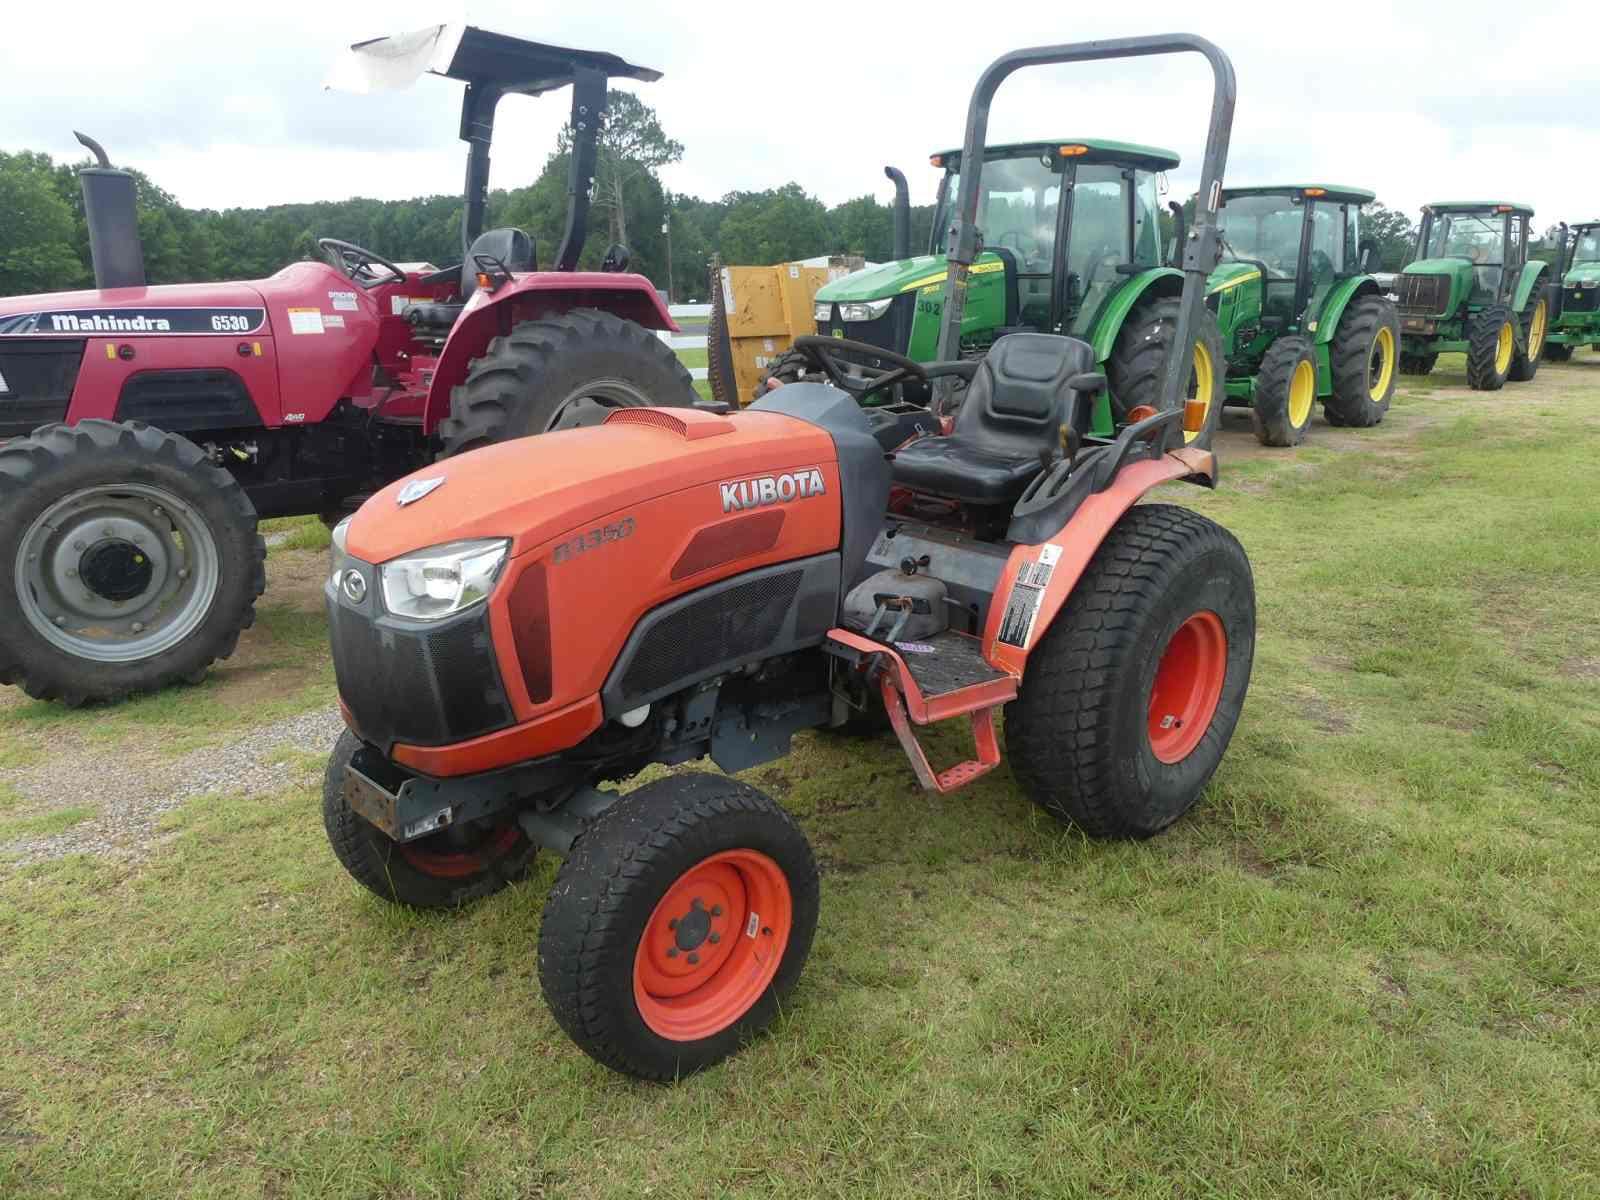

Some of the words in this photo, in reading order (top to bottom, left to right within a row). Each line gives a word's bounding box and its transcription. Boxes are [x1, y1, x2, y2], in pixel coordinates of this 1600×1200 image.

[51, 314, 171, 331] Mahindra
[211, 314, 249, 331] 6530
[720, 469, 826, 512] KUBOTA
